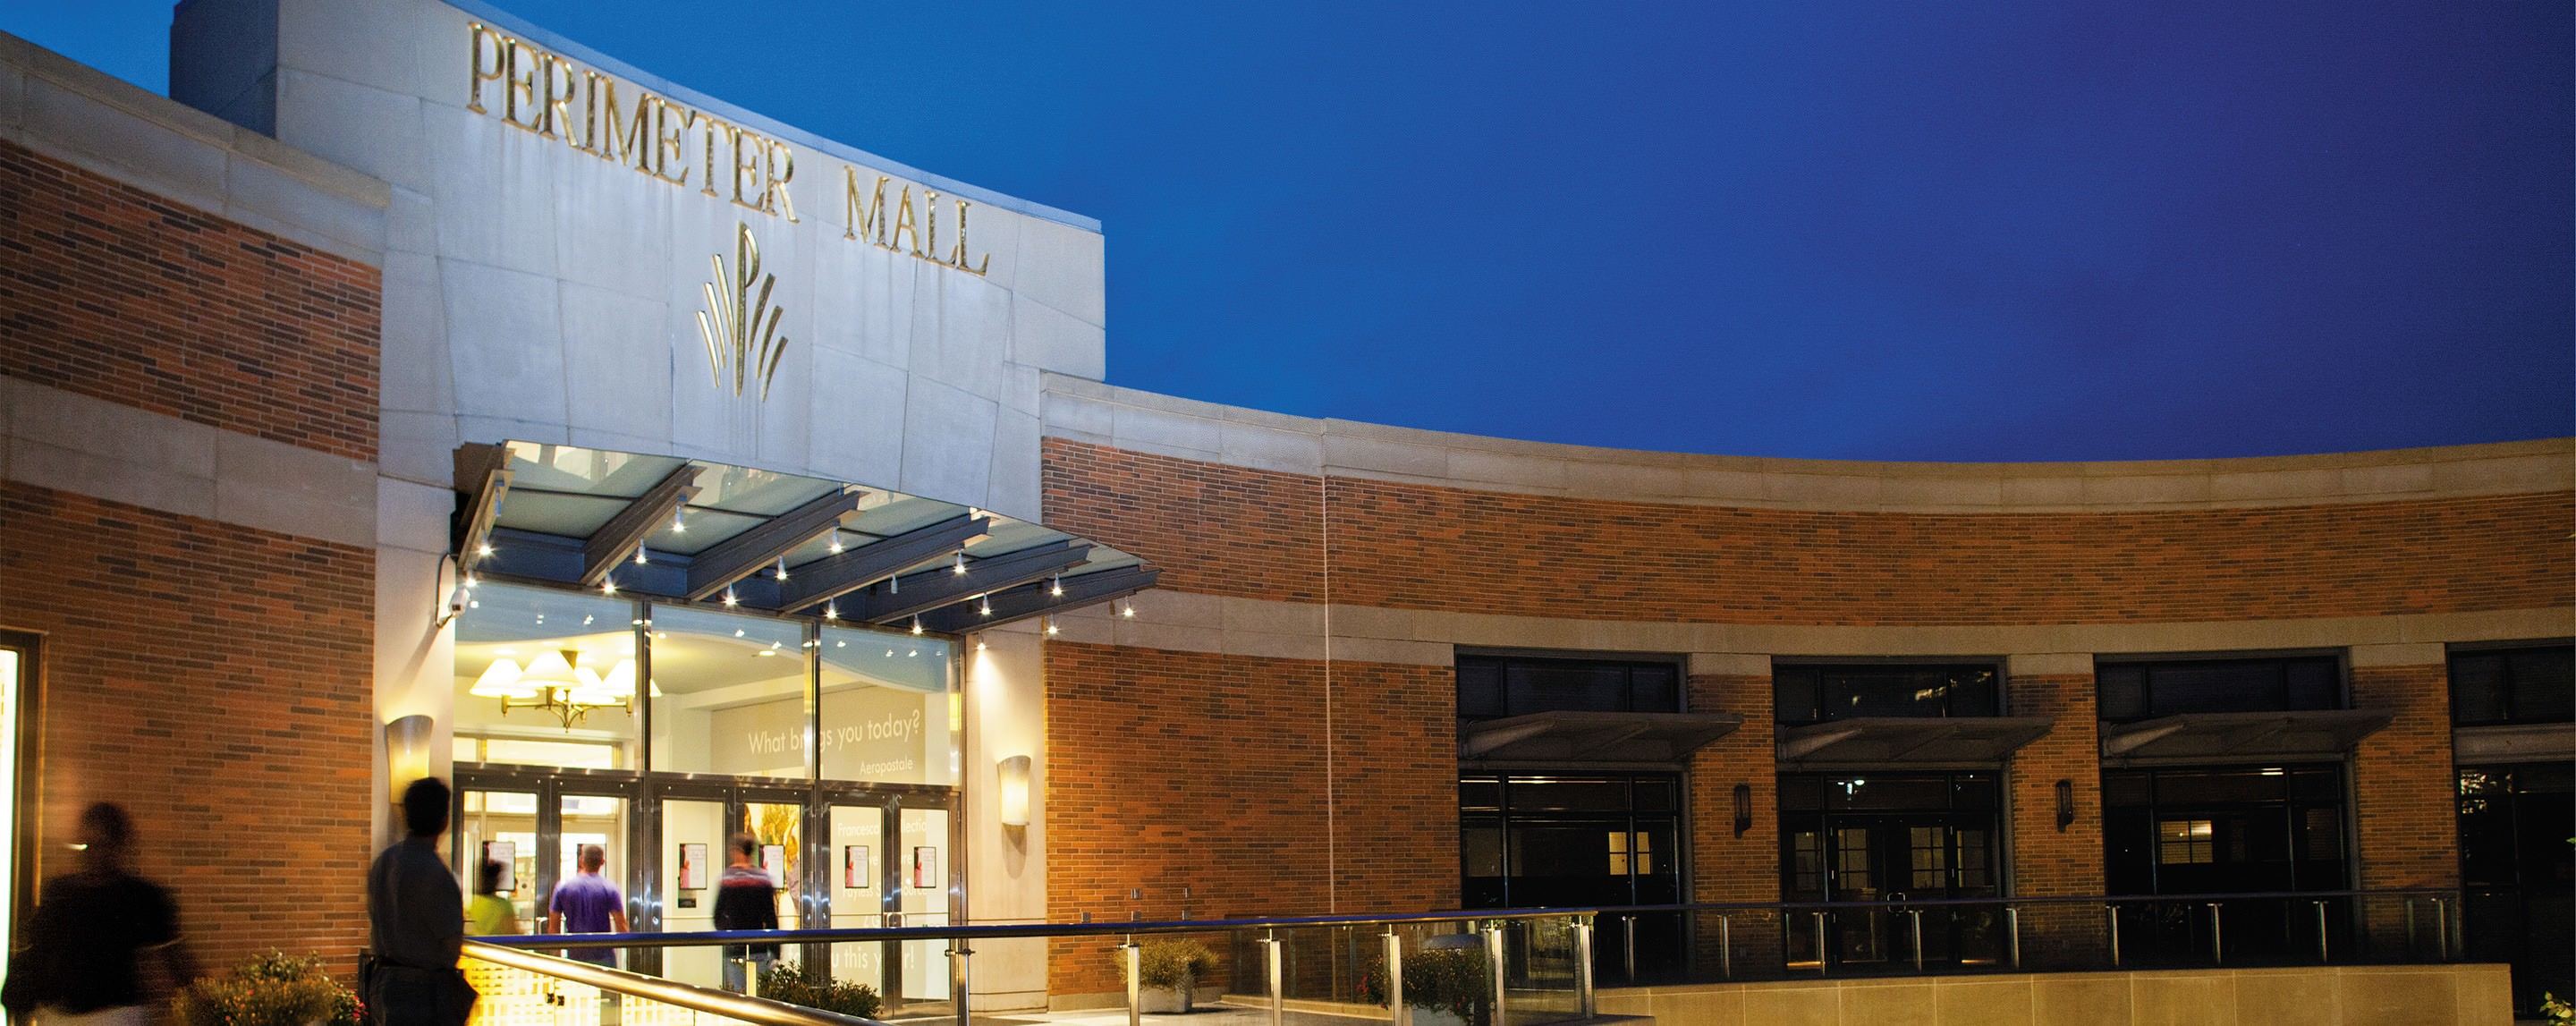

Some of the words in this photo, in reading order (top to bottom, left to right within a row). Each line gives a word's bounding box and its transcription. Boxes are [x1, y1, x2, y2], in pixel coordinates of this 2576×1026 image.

[467, 21, 800, 223] PERIMETER
[843, 165, 990, 276] MALL
[748, 729, 786, 754] What
[791, 726, 832, 753] brgs
[836, 725, 863, 751] you
[867, 708, 920, 742] today?
[859, 755, 914, 777] Aeropostale
[843, 945, 869, 969] this
